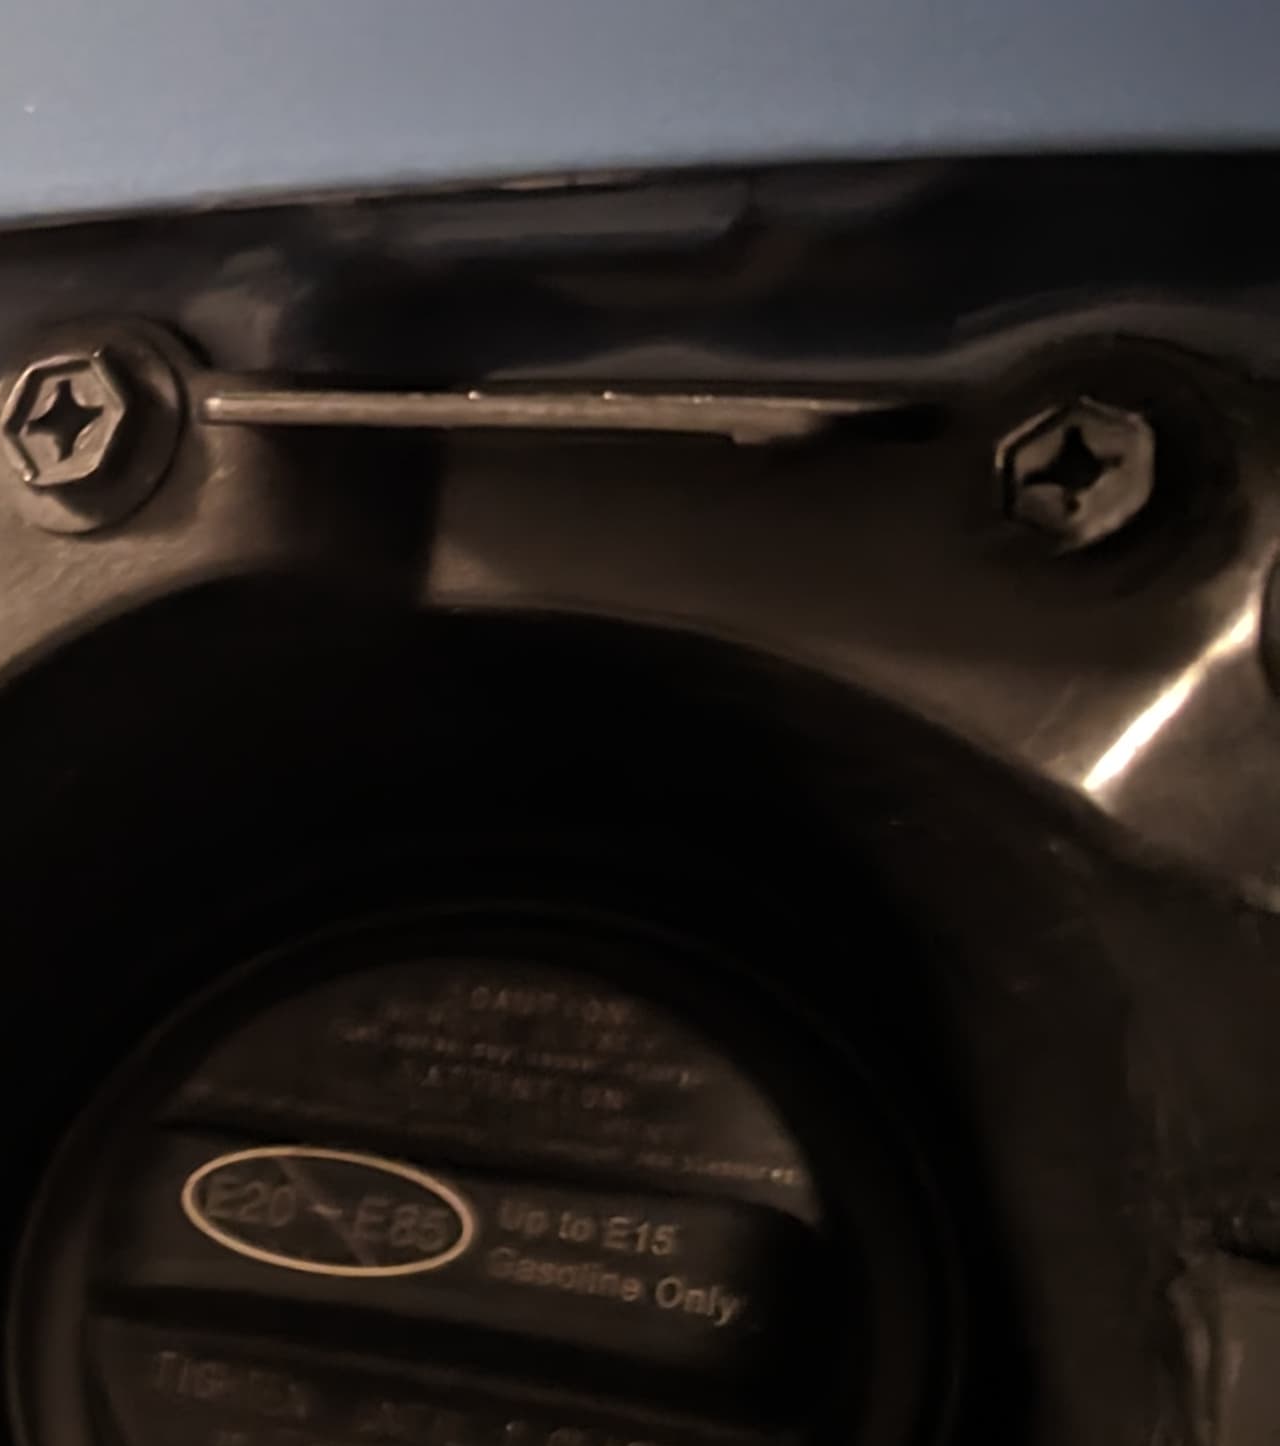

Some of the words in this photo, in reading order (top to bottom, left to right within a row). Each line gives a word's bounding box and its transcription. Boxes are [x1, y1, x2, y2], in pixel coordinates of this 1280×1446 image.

[497, 1199, 550, 1238] Up
[558, 1203, 595, 1243] to
[601, 1214, 679, 1256] E15
[486, 1246, 641, 1302] Gasoline
[655, 1275, 742, 1326] Only
